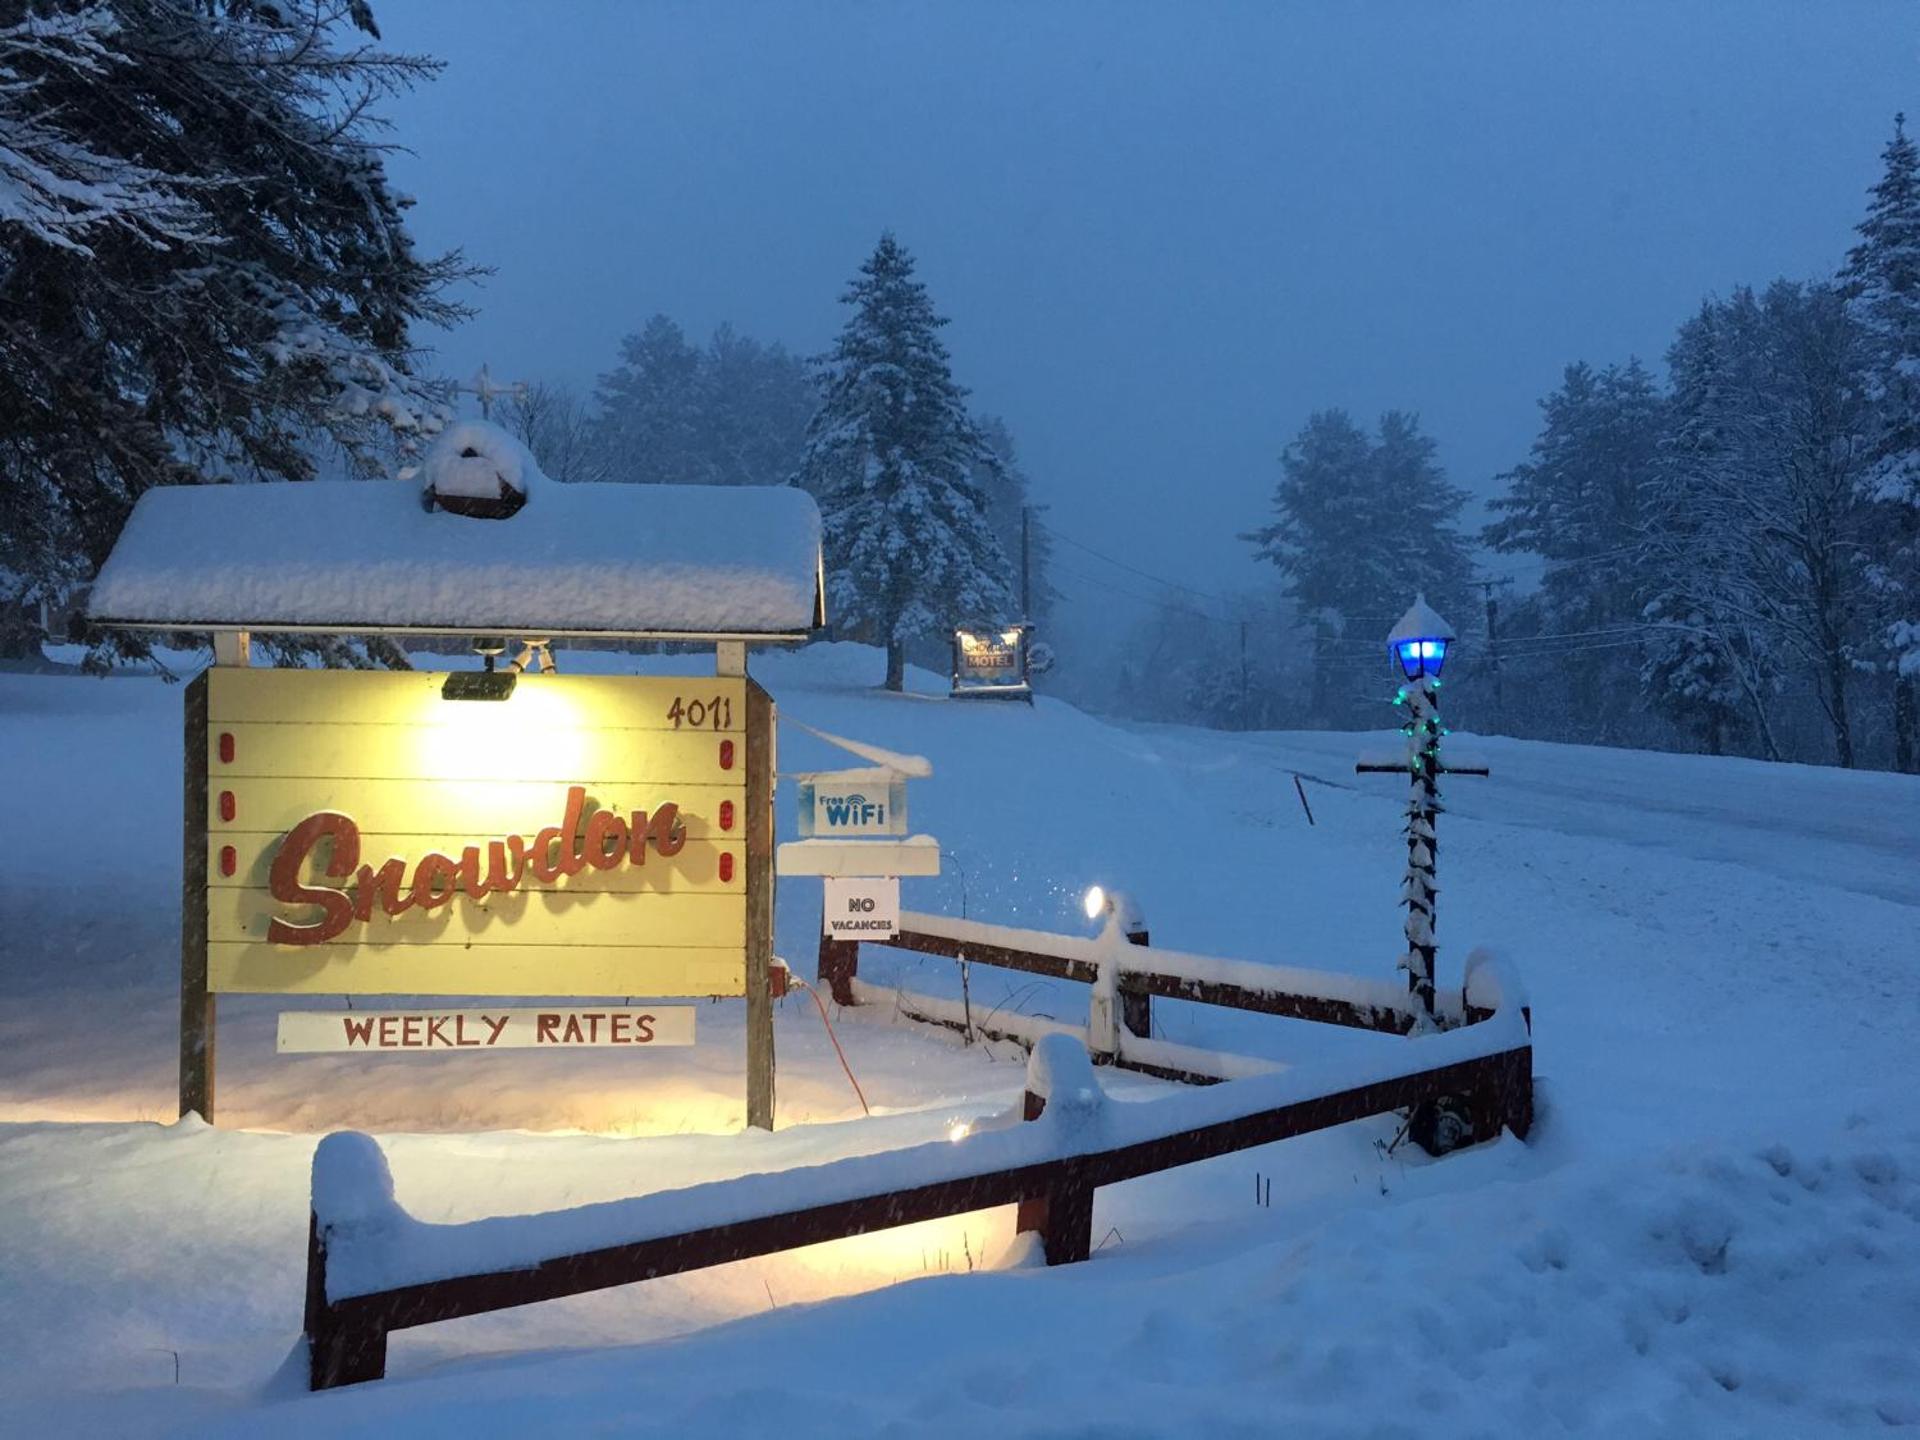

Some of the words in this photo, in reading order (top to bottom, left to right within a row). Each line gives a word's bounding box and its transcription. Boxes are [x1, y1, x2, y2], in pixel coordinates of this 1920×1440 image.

[968, 656, 1011, 666] MOTEL
[819, 795, 844, 806] Free
[826, 804, 884, 826] WiFi
[267, 786, 687, 946] Snowdon
[848, 898, 876, 912] NO
[831, 920, 893, 930] VACANCIES
[343, 1015, 509, 1047] WEEKLY
[537, 1013, 656, 1044] RATES
